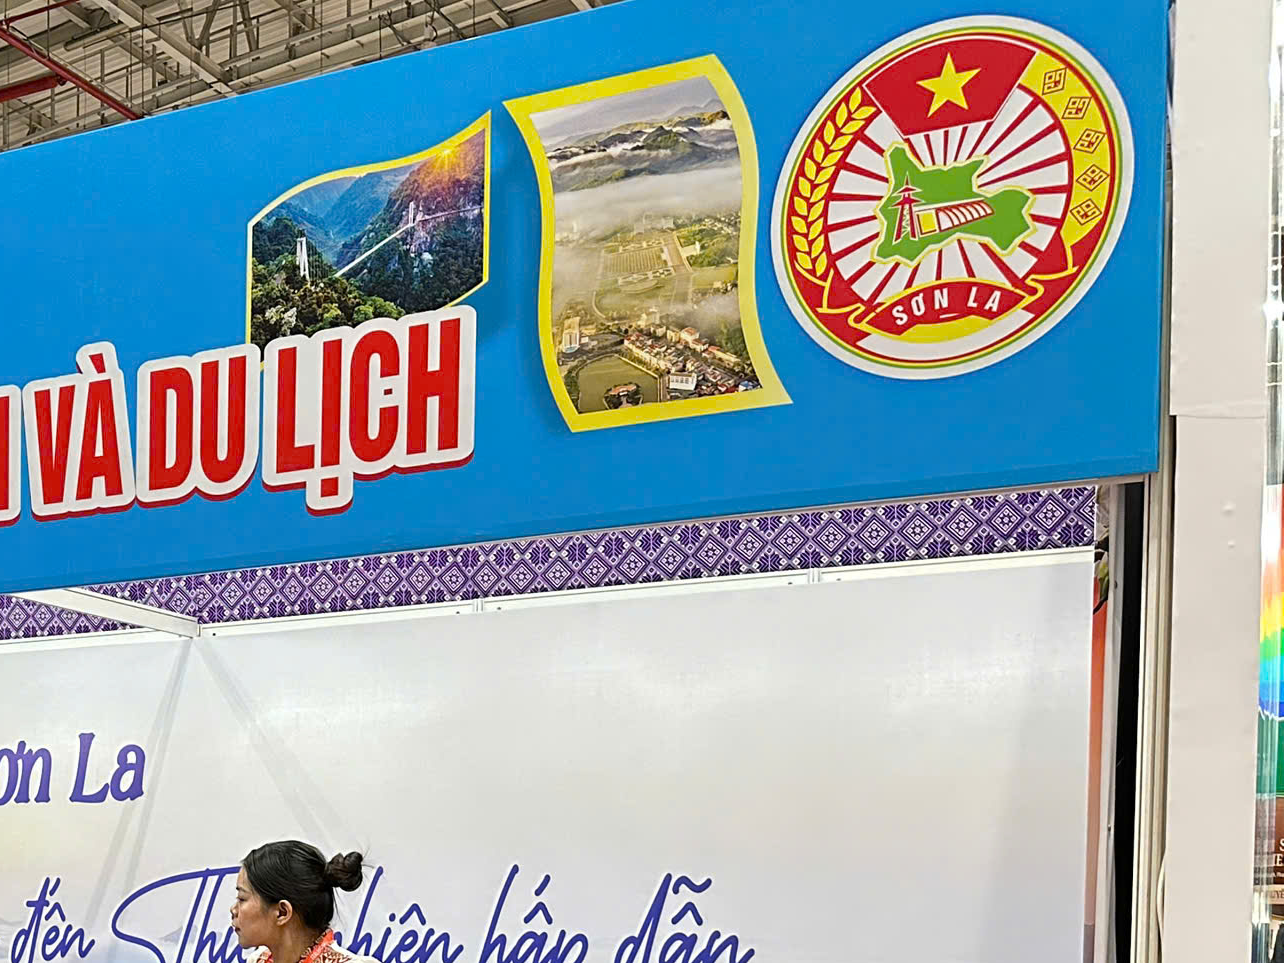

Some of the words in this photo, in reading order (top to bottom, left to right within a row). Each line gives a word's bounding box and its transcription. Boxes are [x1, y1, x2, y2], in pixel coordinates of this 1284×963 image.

[892, 286, 949, 325] SƠN
[967, 286, 1001, 313] LA
[31, 351, 128, 514] VÀ
[146, 354, 252, 500] DU
[268, 316, 473, 515] LỊCH
[69, 733, 146, 804] La
